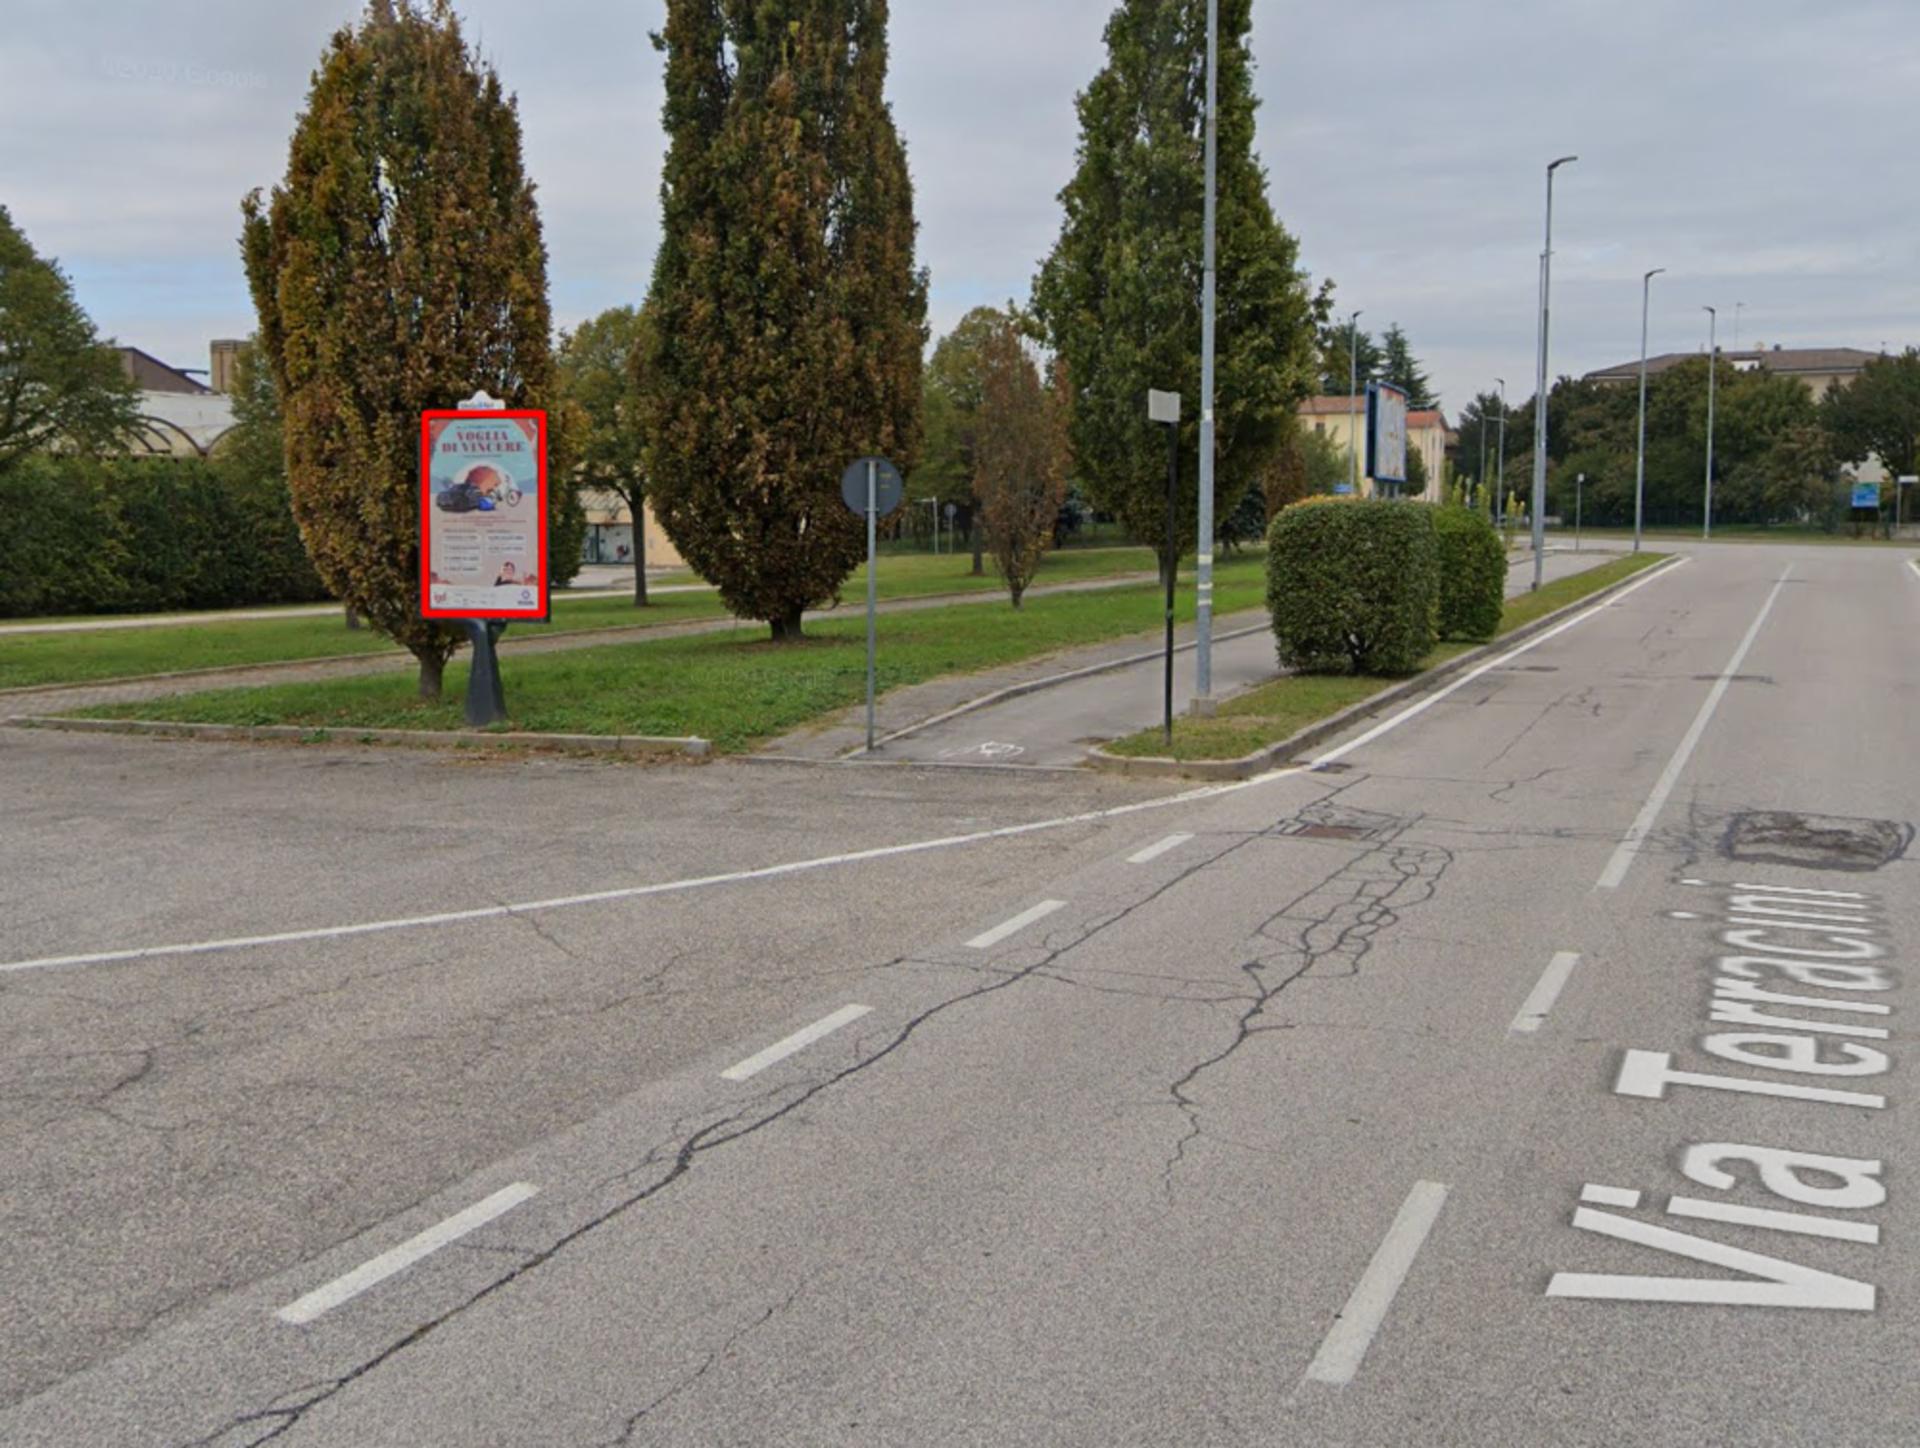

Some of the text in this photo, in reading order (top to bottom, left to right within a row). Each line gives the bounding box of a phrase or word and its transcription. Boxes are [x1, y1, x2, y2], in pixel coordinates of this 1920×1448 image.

[456, 431, 509, 441] VOGLIA
[441, 443, 525, 453] DI VINCERE
